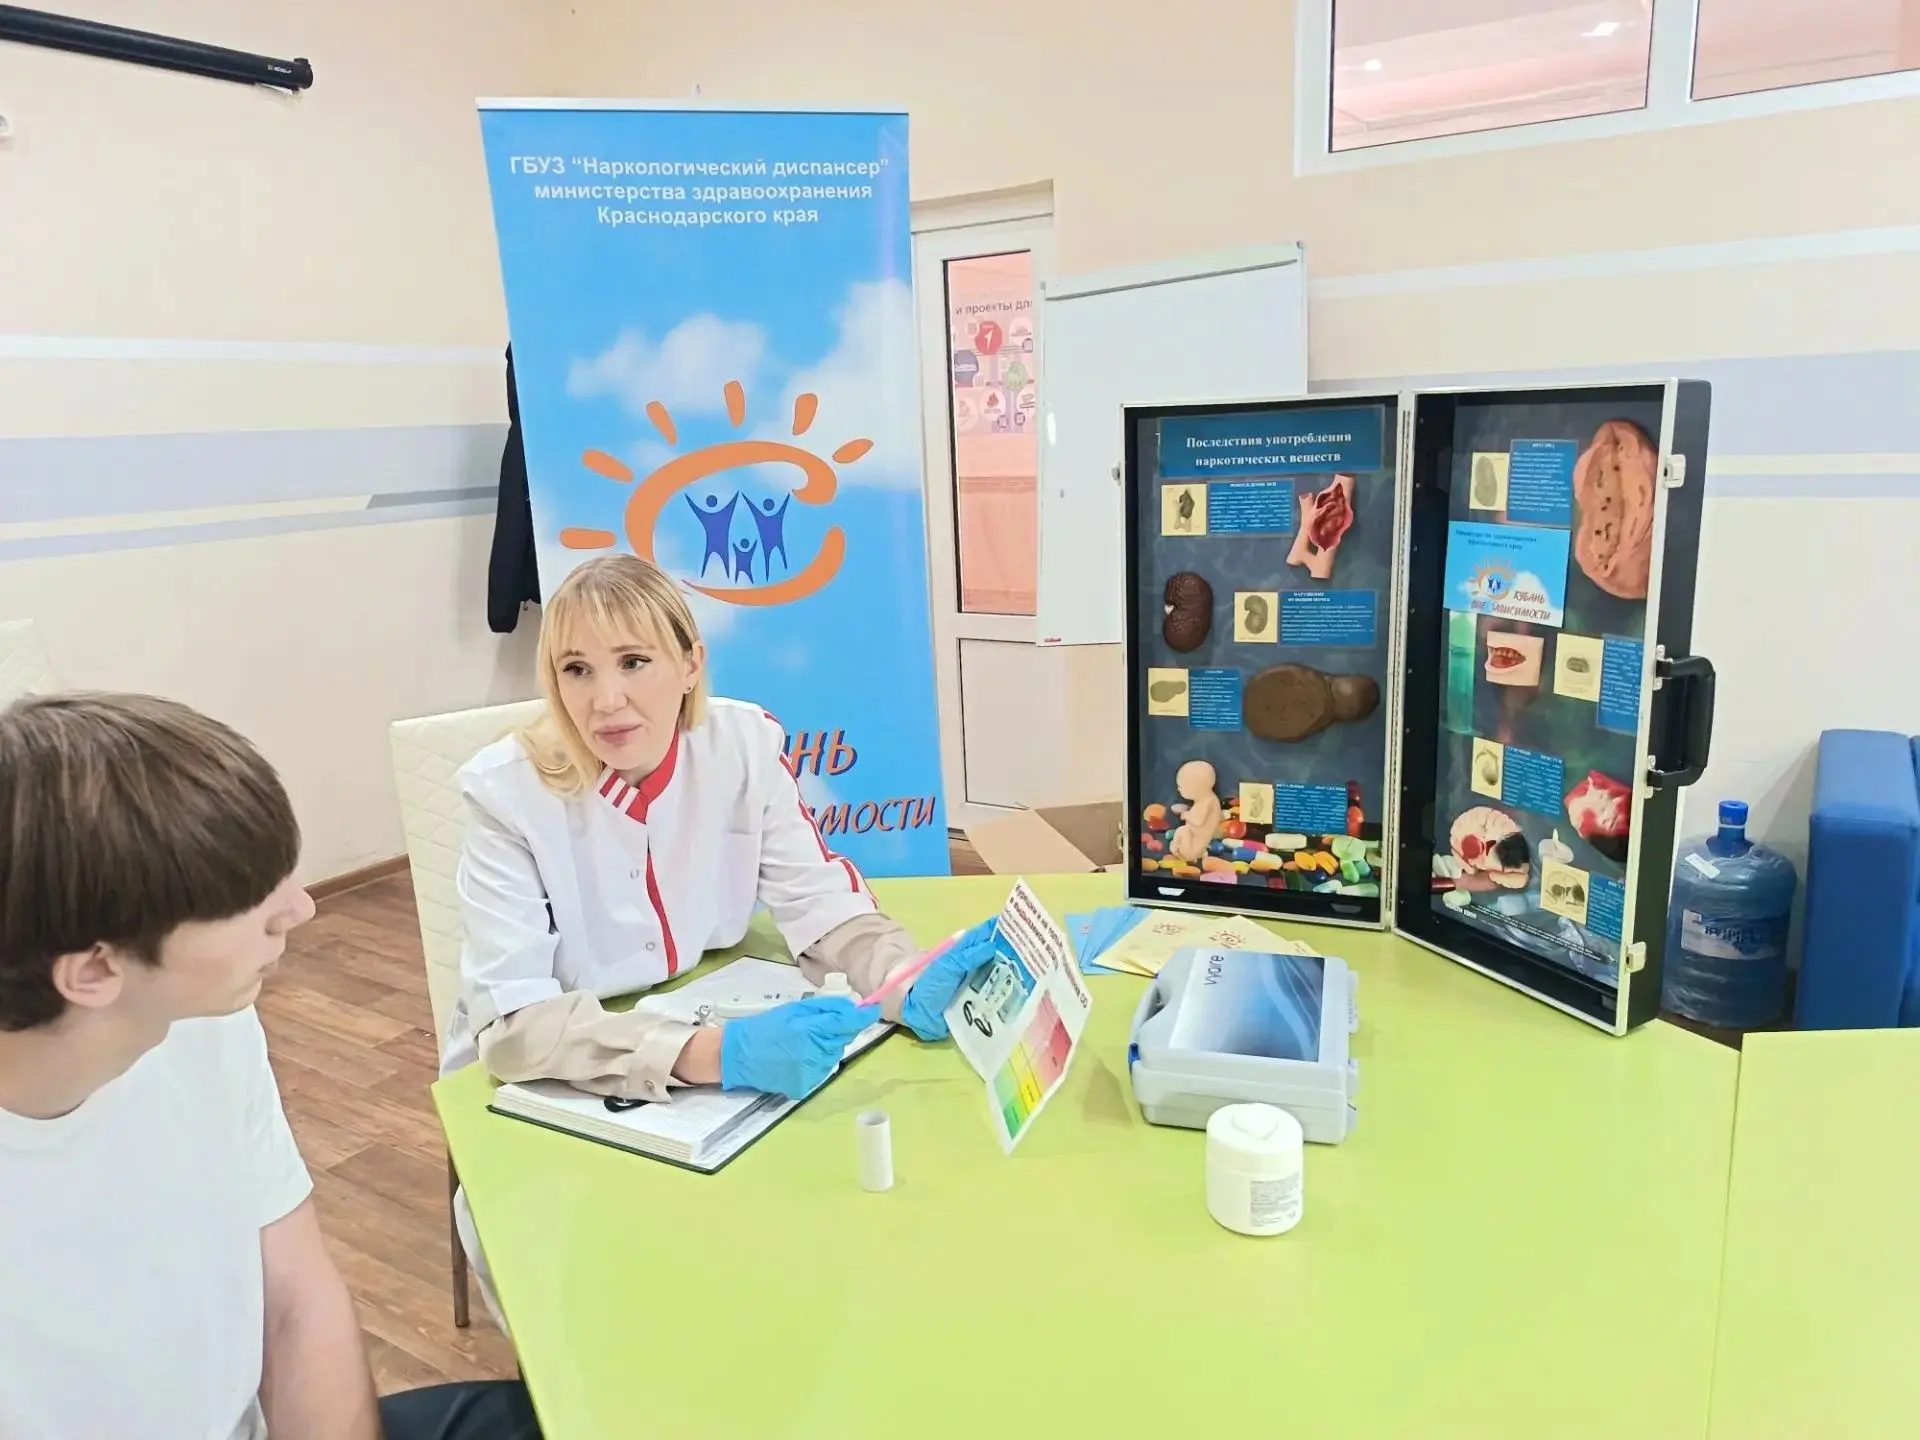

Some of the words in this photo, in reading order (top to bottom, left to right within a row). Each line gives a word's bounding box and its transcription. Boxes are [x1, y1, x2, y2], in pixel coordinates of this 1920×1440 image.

[509, 156, 566, 175] ГБУЗ
[534, 183, 686, 202] министерства
[691, 183, 873, 202] здравоохранения
[597, 206, 767, 228] Краснодарского
[772, 208, 819, 226] края
[966, 302, 1012, 316] проекты
[1015, 299, 1033, 312] дл
[1186, 435, 1263, 449] Последствия
[1266, 431, 1352, 447] употребления
[1196, 455, 1286, 468] наркотических
[1289, 451, 1342, 465] веществ
[1203, 954, 1225, 986] vyaire
